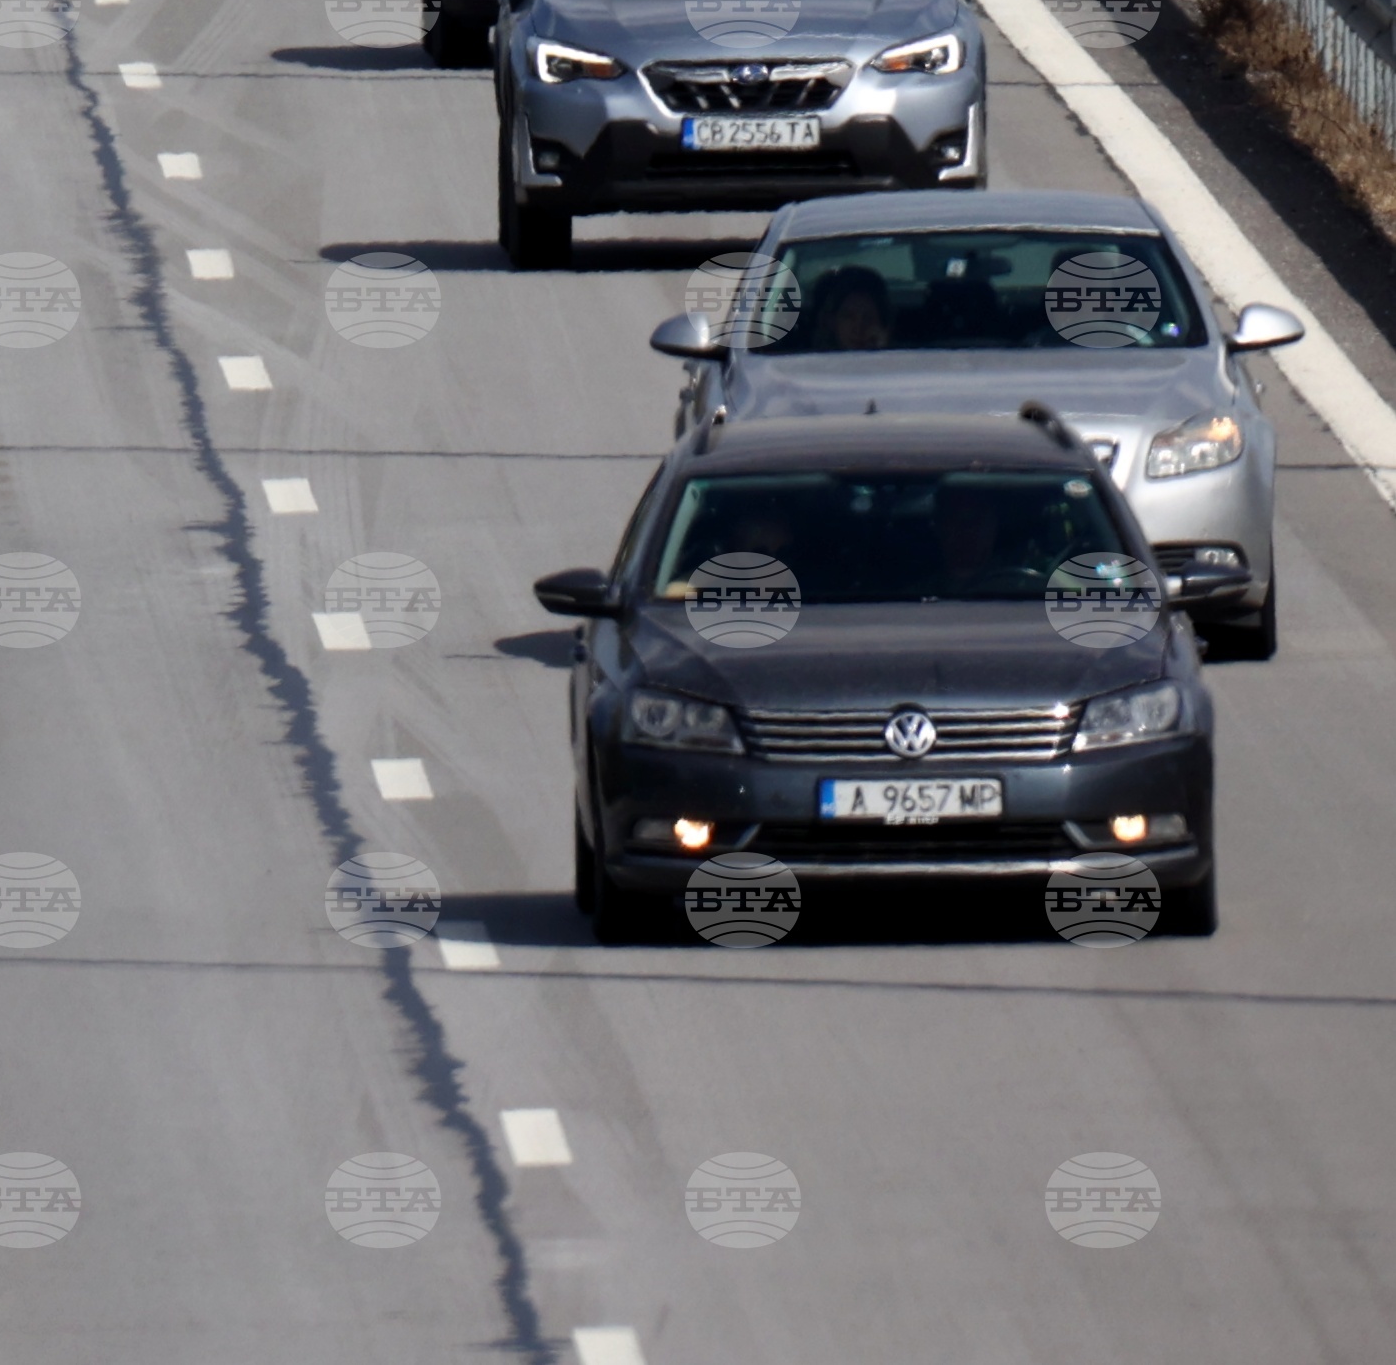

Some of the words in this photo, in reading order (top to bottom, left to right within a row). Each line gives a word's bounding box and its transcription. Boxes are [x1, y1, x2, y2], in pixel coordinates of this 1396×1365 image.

[729, 121, 781, 144] 2556
[786, 121, 815, 143] TA
[851, 786, 867, 813] A
[883, 785, 952, 812] 9657
